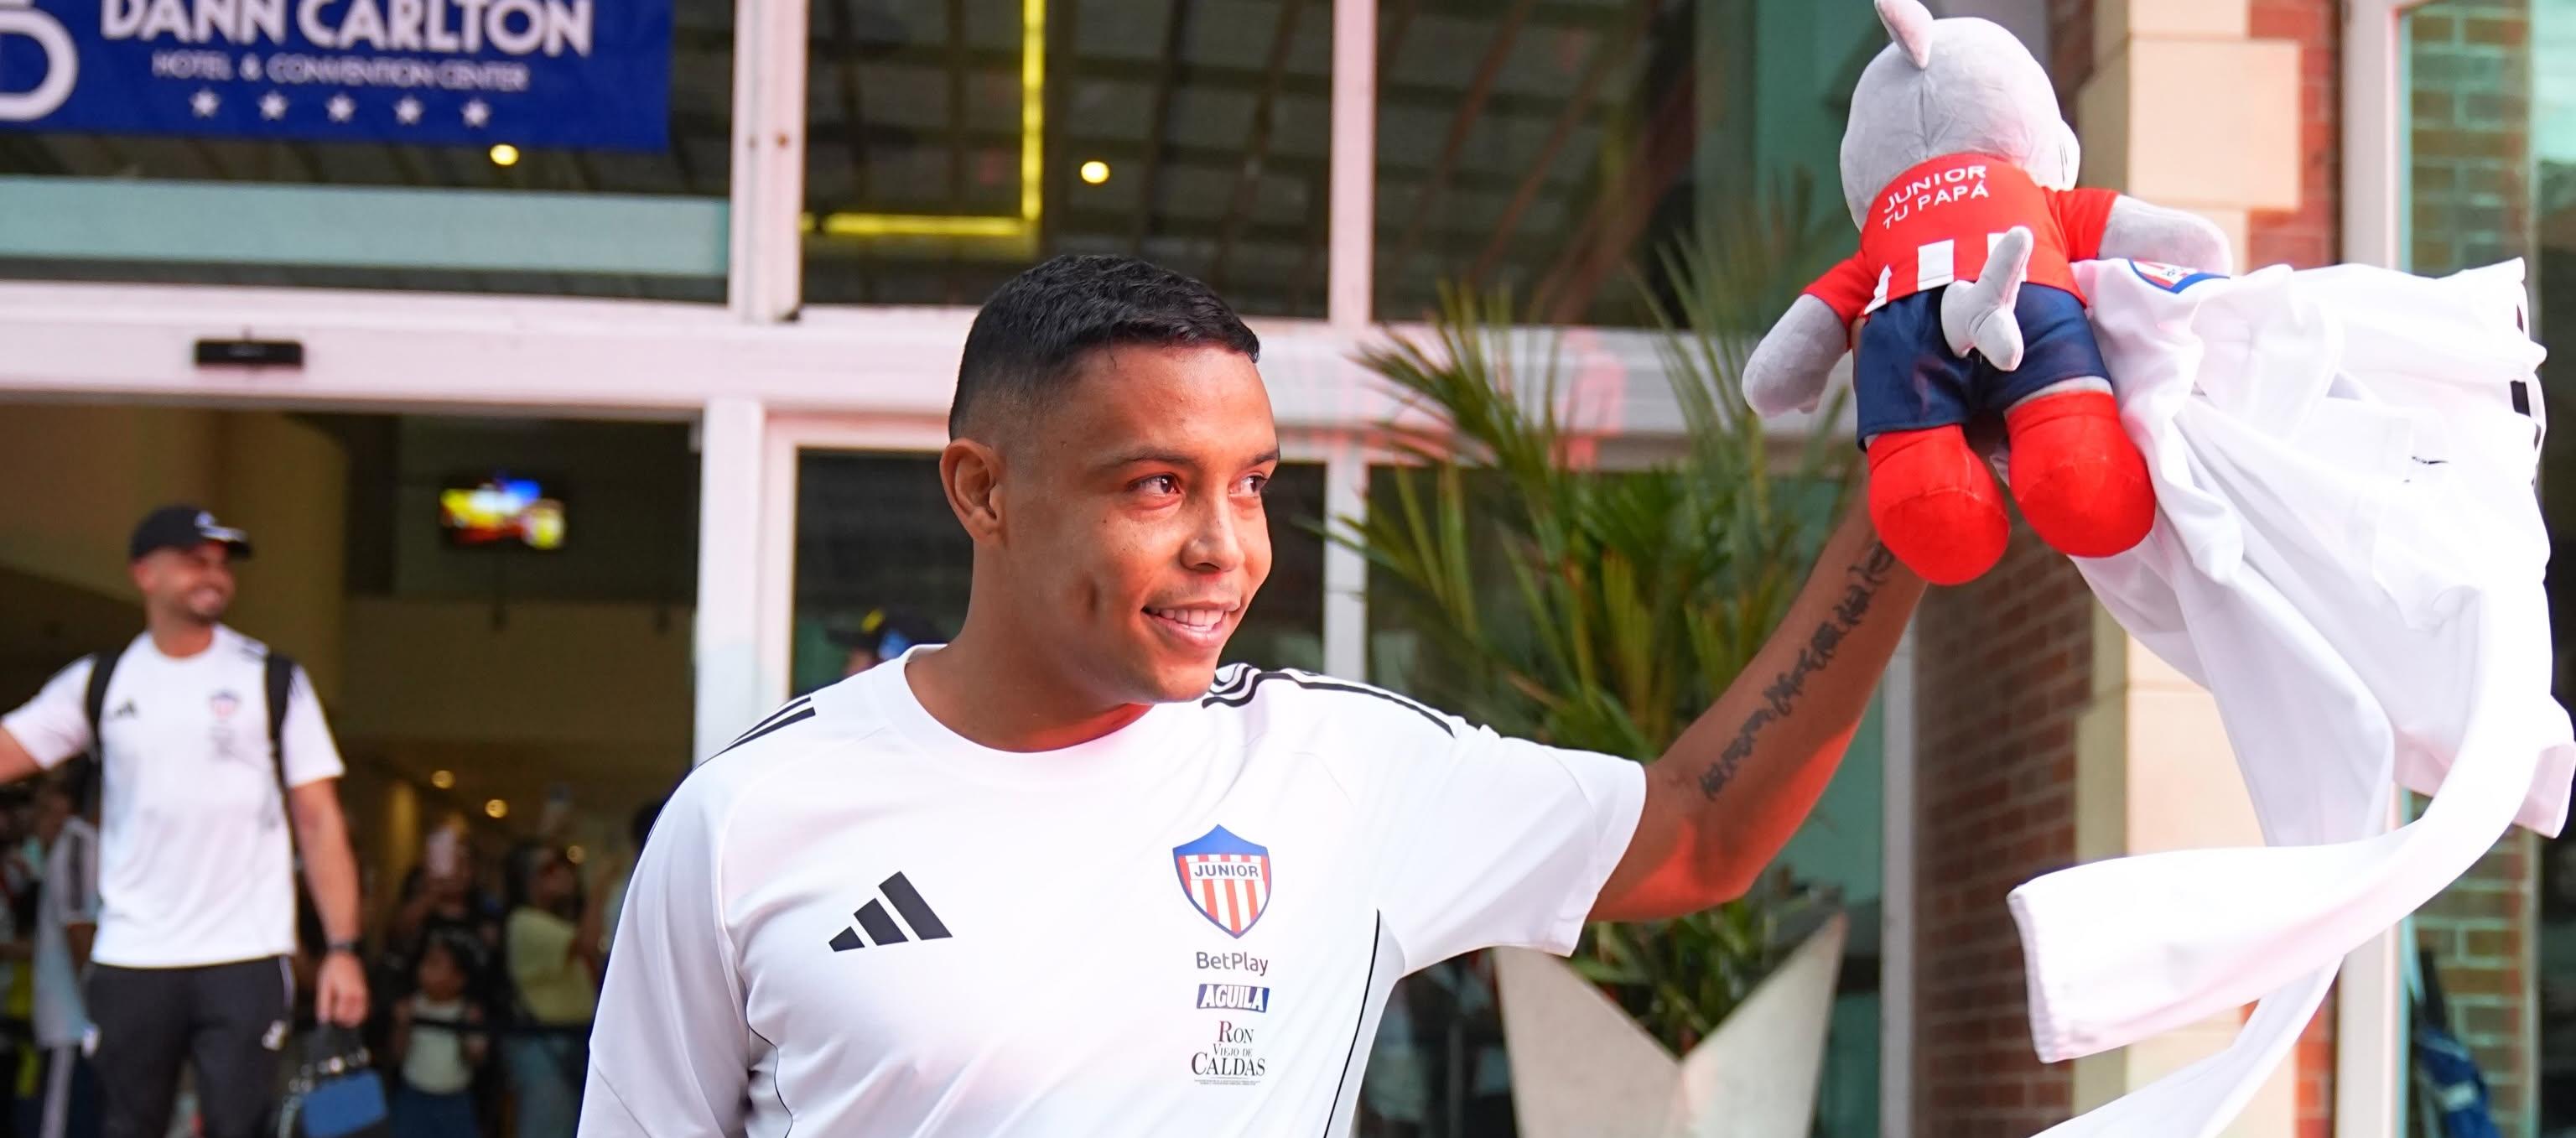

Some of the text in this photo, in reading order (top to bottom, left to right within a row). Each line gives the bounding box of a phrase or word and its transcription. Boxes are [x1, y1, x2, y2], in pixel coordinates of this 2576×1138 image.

[101, 0, 592, 56] DANN CARLTON
[152, 50, 529, 91] HOTEL & CONVENTION CENTER
[1883, 179, 1990, 229] TU PAPÁ
[1884, 165, 1987, 214] JUNIOR
[1194, 865, 1259, 878] JUNIOR
[1196, 952, 1269, 976] BetPlay
